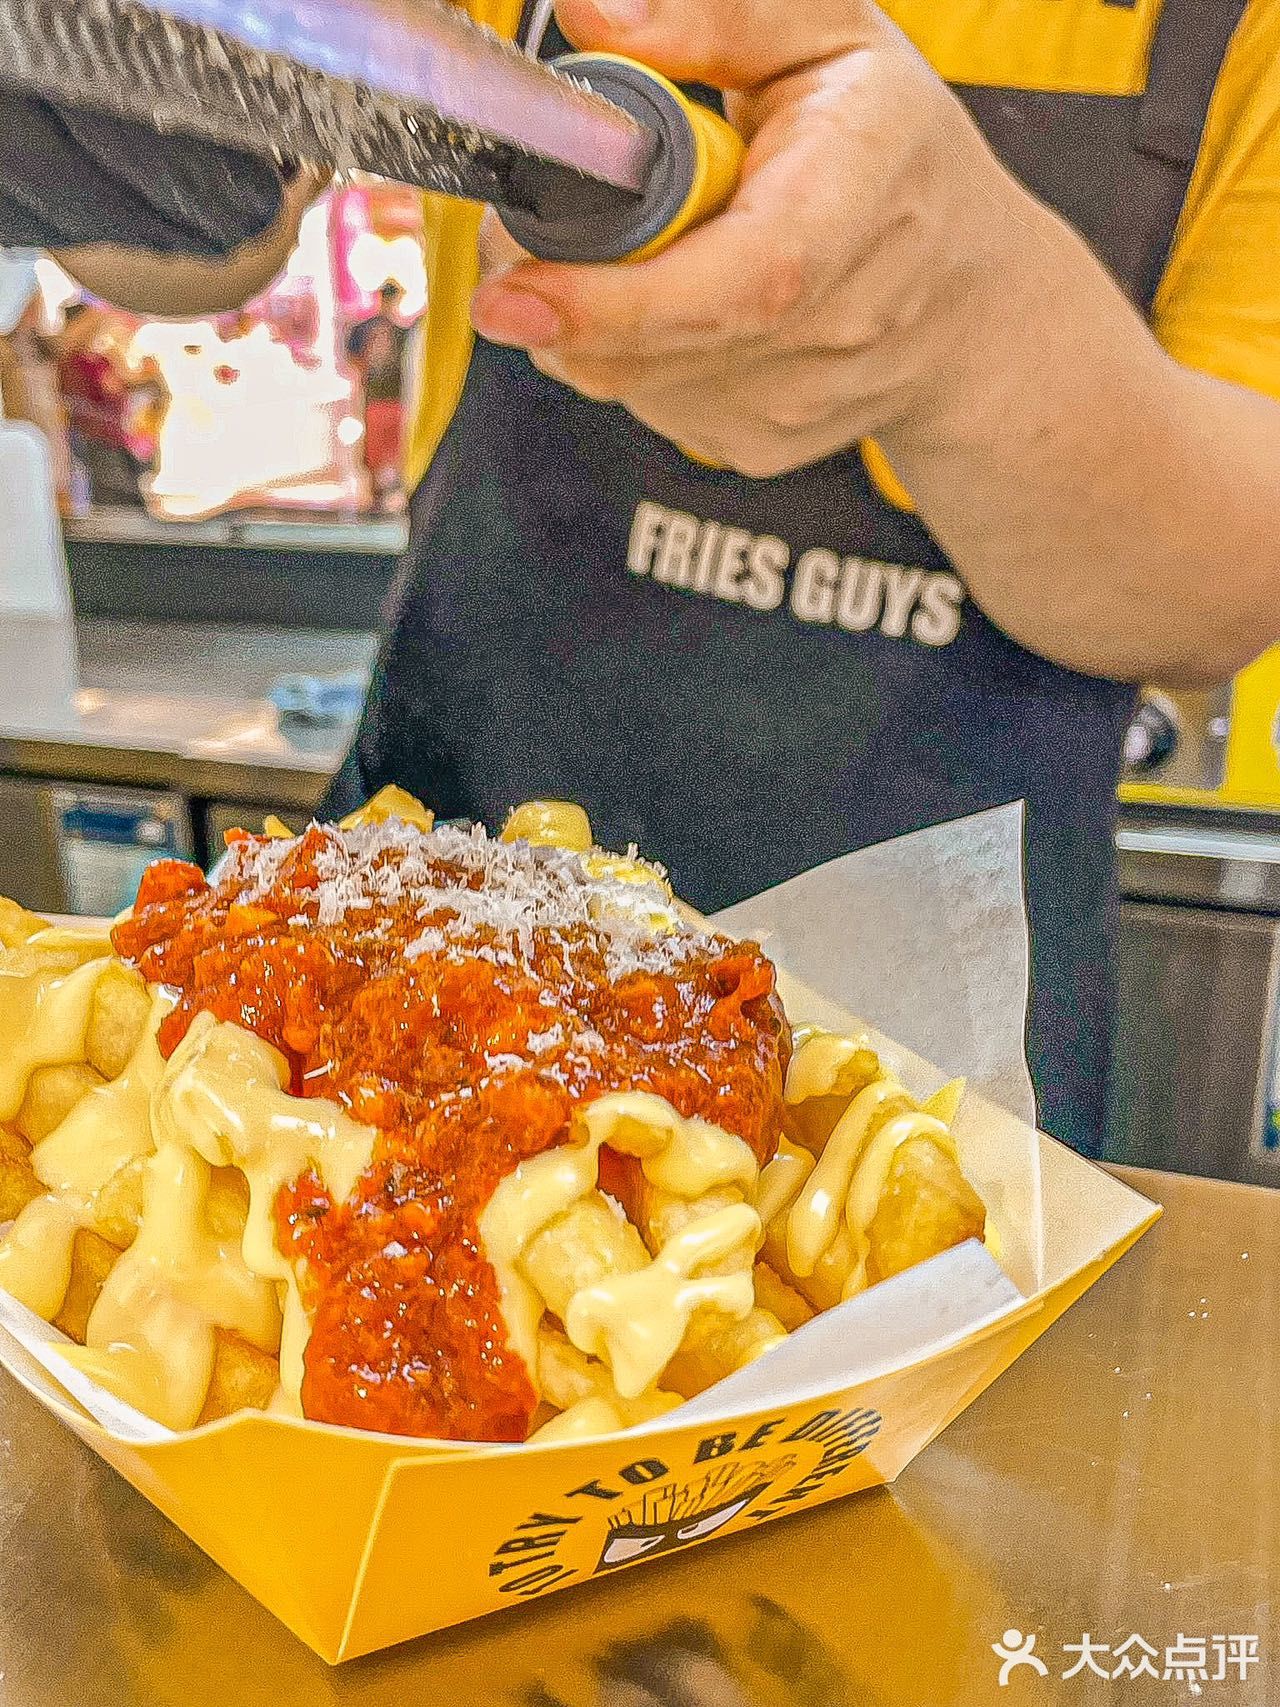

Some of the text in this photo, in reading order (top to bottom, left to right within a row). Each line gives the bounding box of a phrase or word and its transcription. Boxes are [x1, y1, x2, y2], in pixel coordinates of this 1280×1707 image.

[627, 500, 964, 648] FRIES GUYS
[488, 1512, 584, 1577] TRY
[566, 1458, 670, 1500] TO
[693, 1417, 788, 1464] BE
